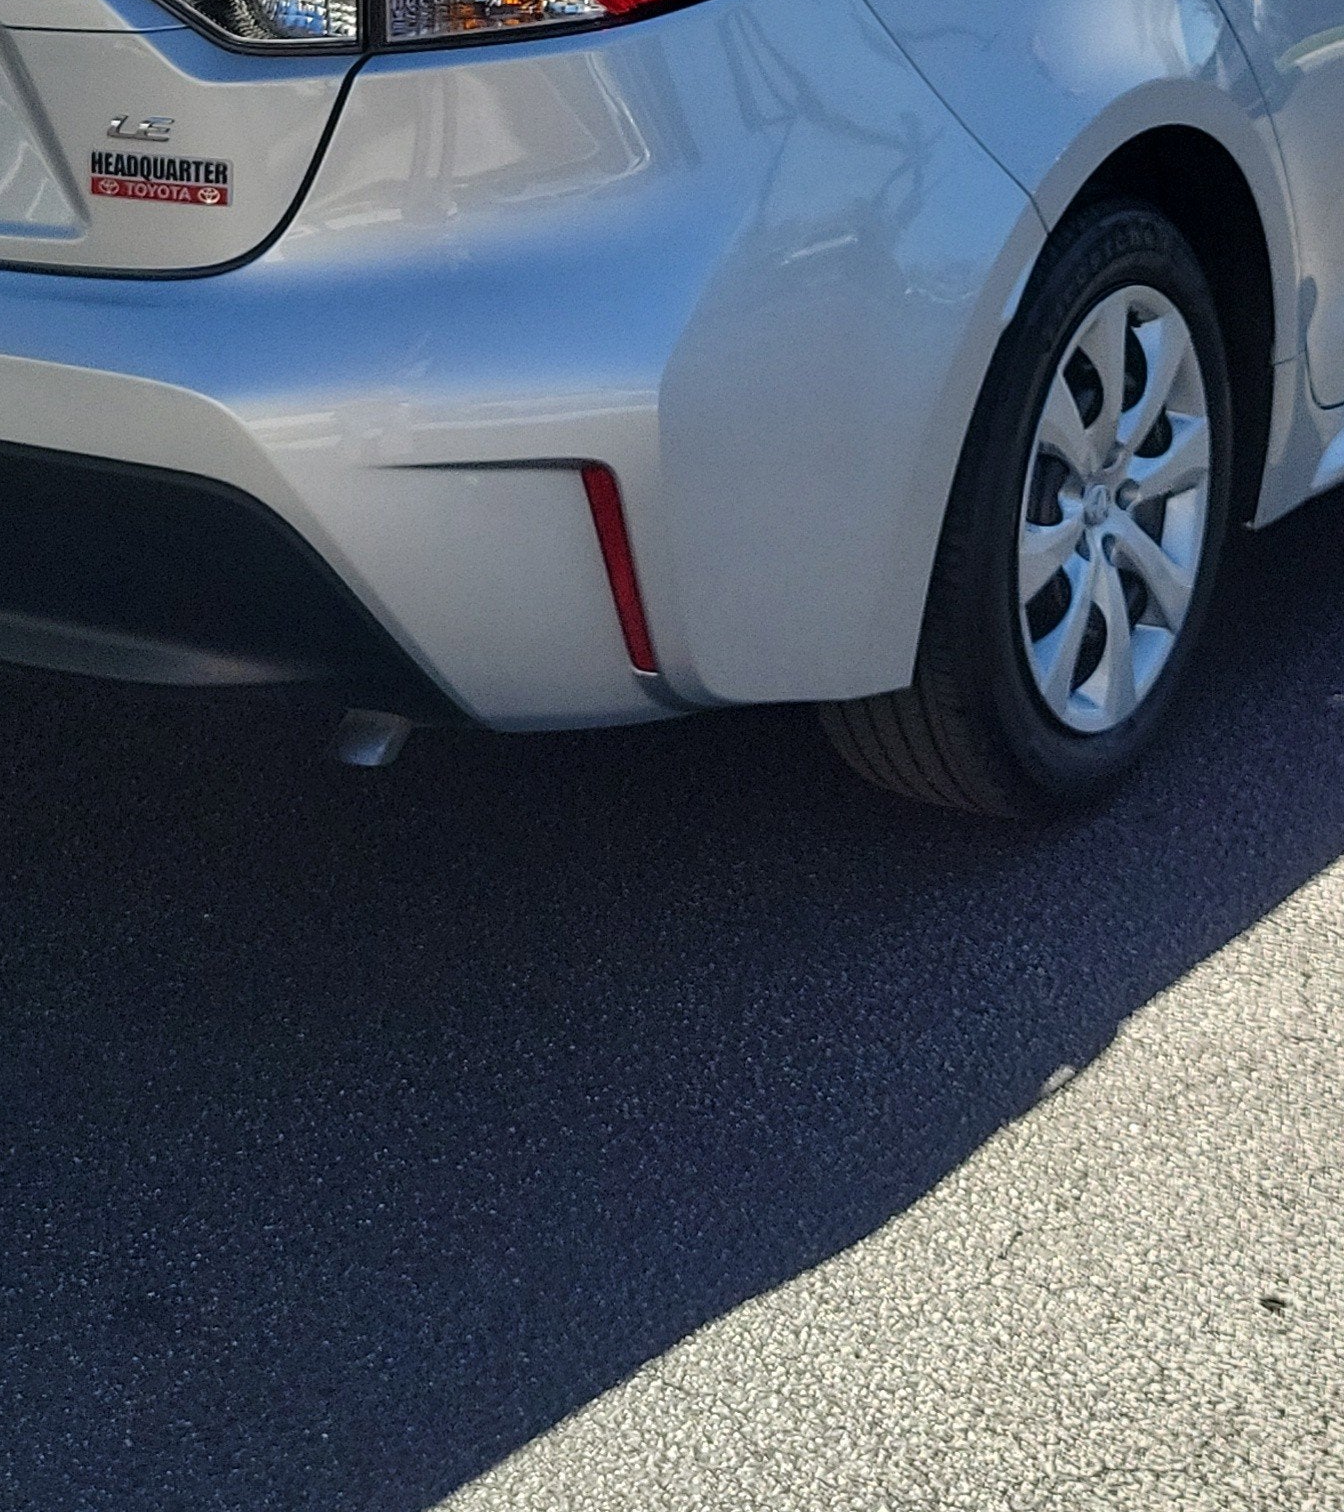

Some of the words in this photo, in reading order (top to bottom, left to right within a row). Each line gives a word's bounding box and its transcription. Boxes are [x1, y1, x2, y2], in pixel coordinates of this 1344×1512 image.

[107, 114, 175, 142] LE
[91, 150, 228, 185] HEADQUARTER
[126, 182, 191, 202] TOYOTA
